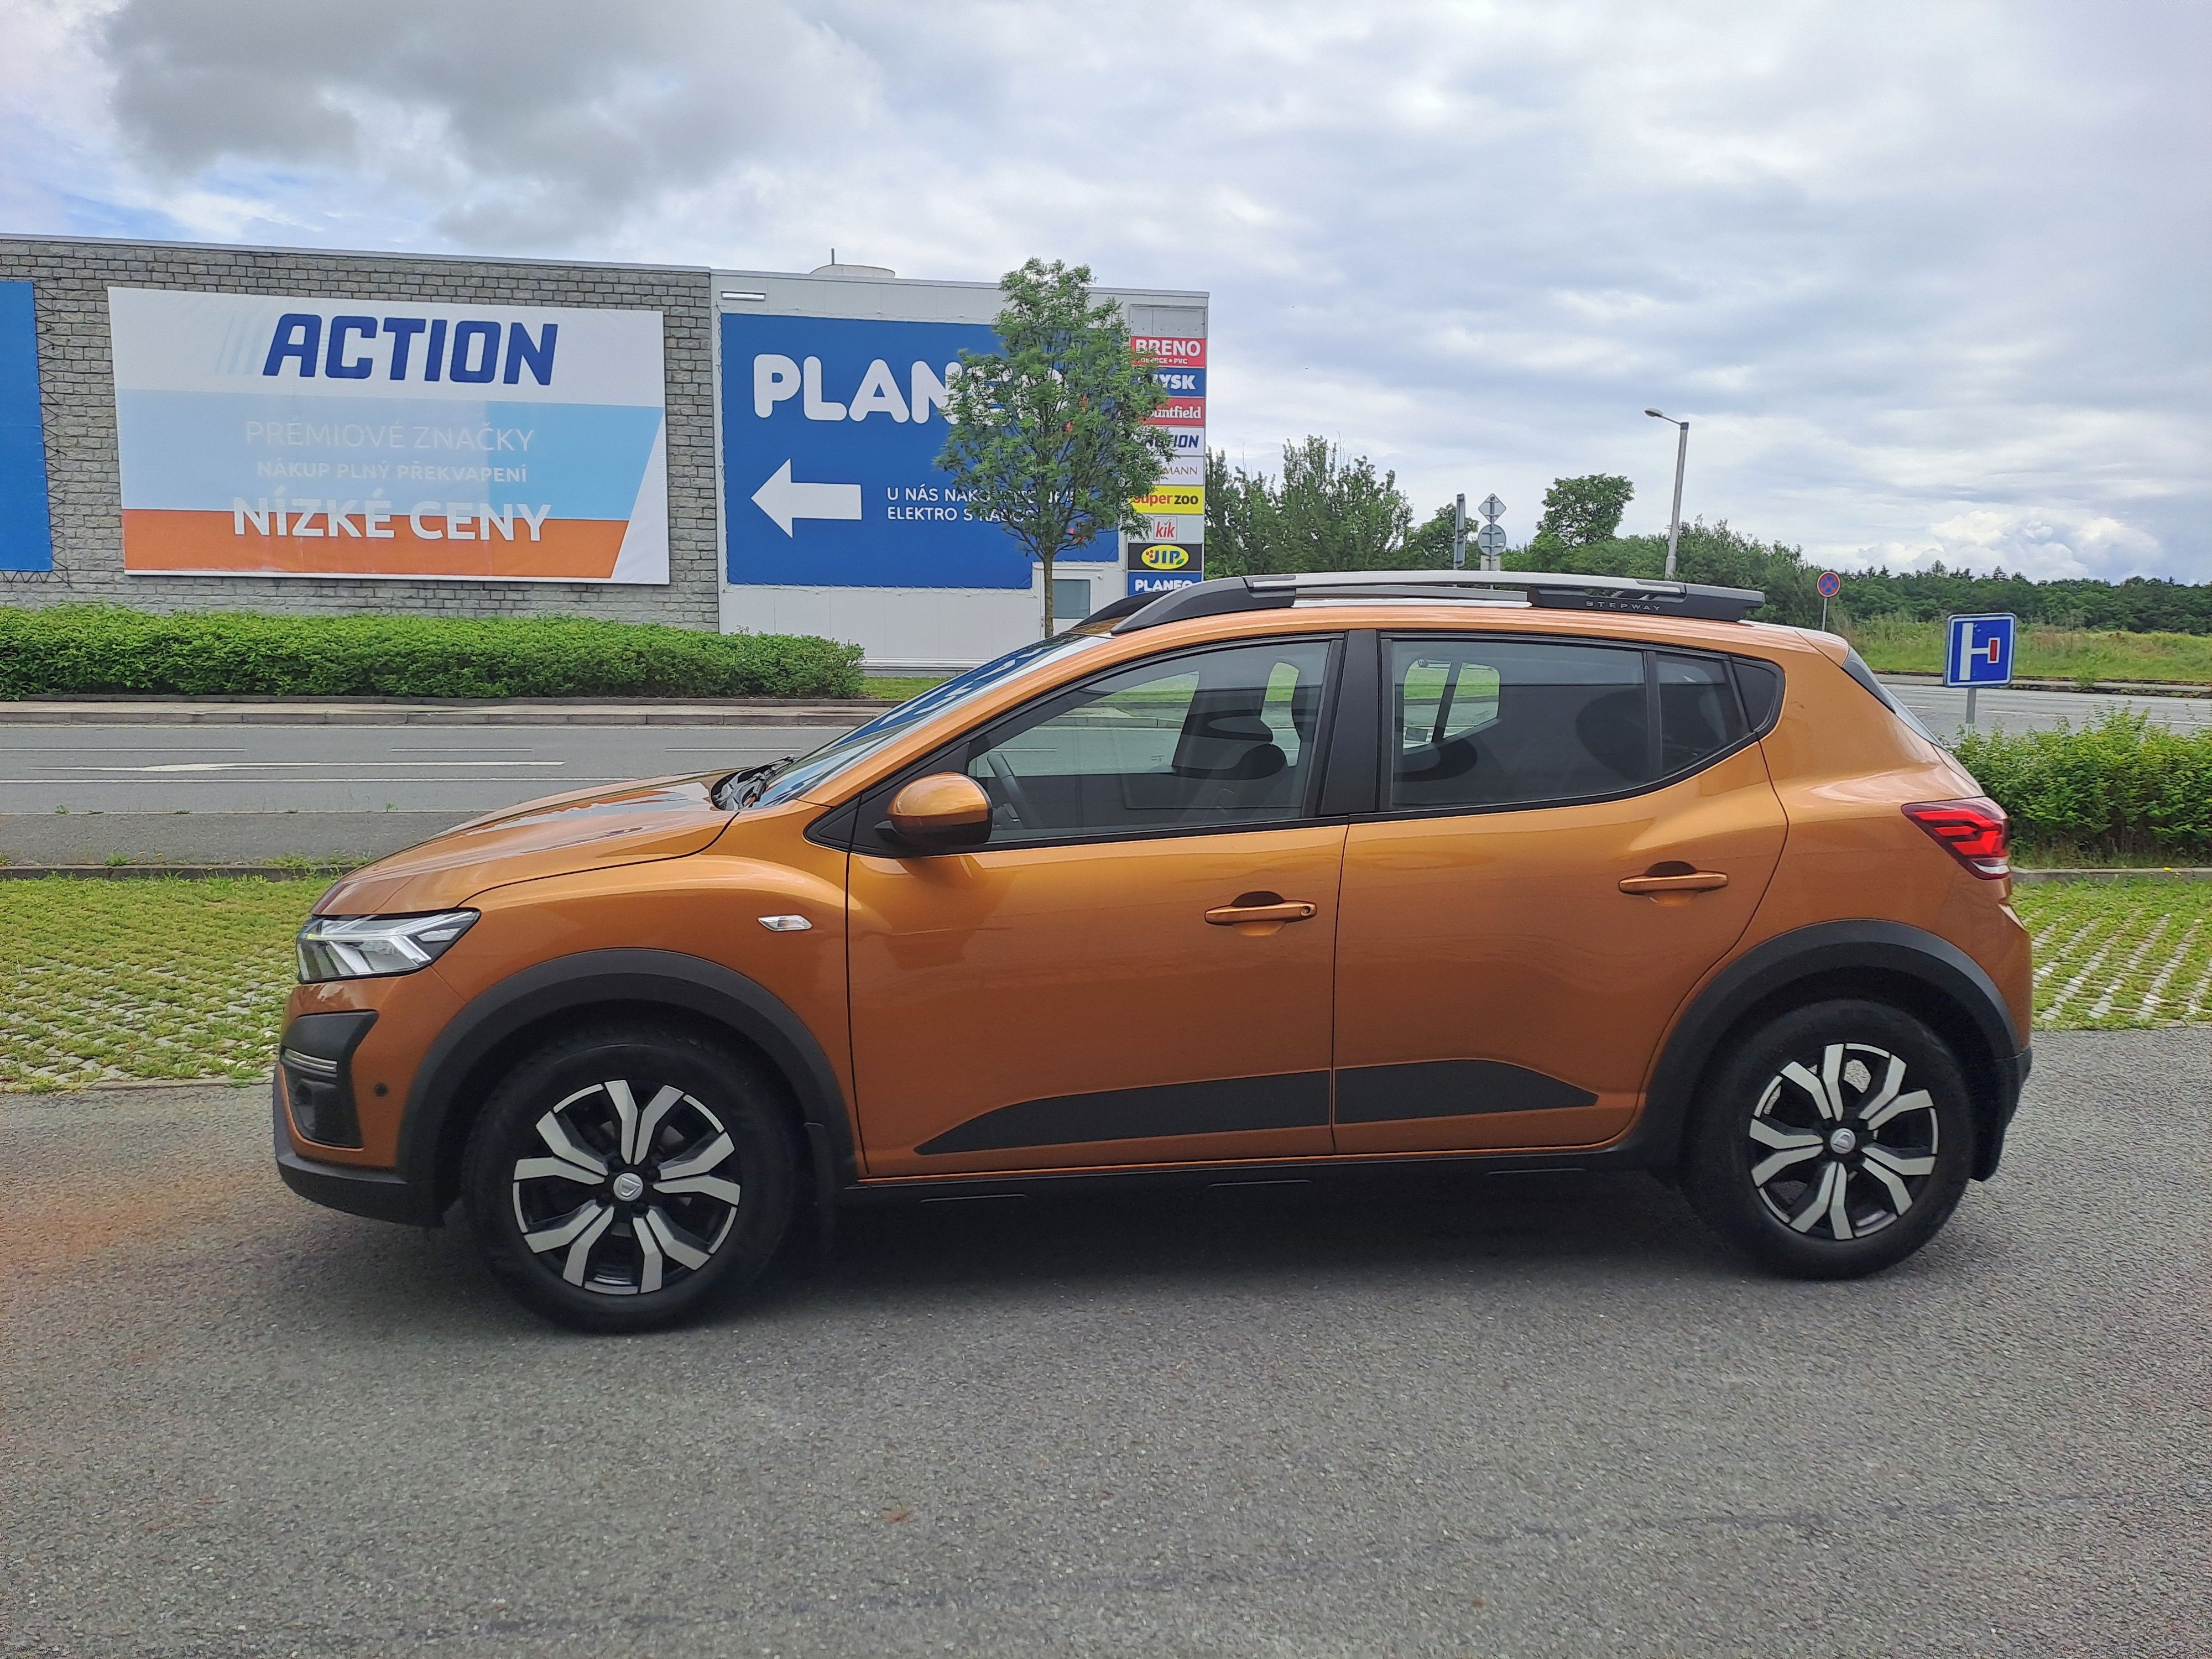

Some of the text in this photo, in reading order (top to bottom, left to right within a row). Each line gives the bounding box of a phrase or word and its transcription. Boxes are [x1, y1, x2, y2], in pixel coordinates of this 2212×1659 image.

[263, 313, 558, 385] ACTION
[1135, 339, 1201, 357] BRENO
[245, 418, 535, 451] PRÉMIOVÉ ZNAČKY
[257, 458, 527, 483] NÁKUP PLNÝ PŘEKVAPENÍ
[886, 487, 899, 501] U
[905, 483, 938, 502] NÁS
[233, 484, 552, 542] NÍZKÉ CENY
[887, 506, 958, 521] ELEKTRO
[963, 508, 973, 521] S
[1155, 519, 1175, 538] kik
[1150, 550, 1181, 564] JIP
[1585, 601, 1661, 612] STEPWAY
